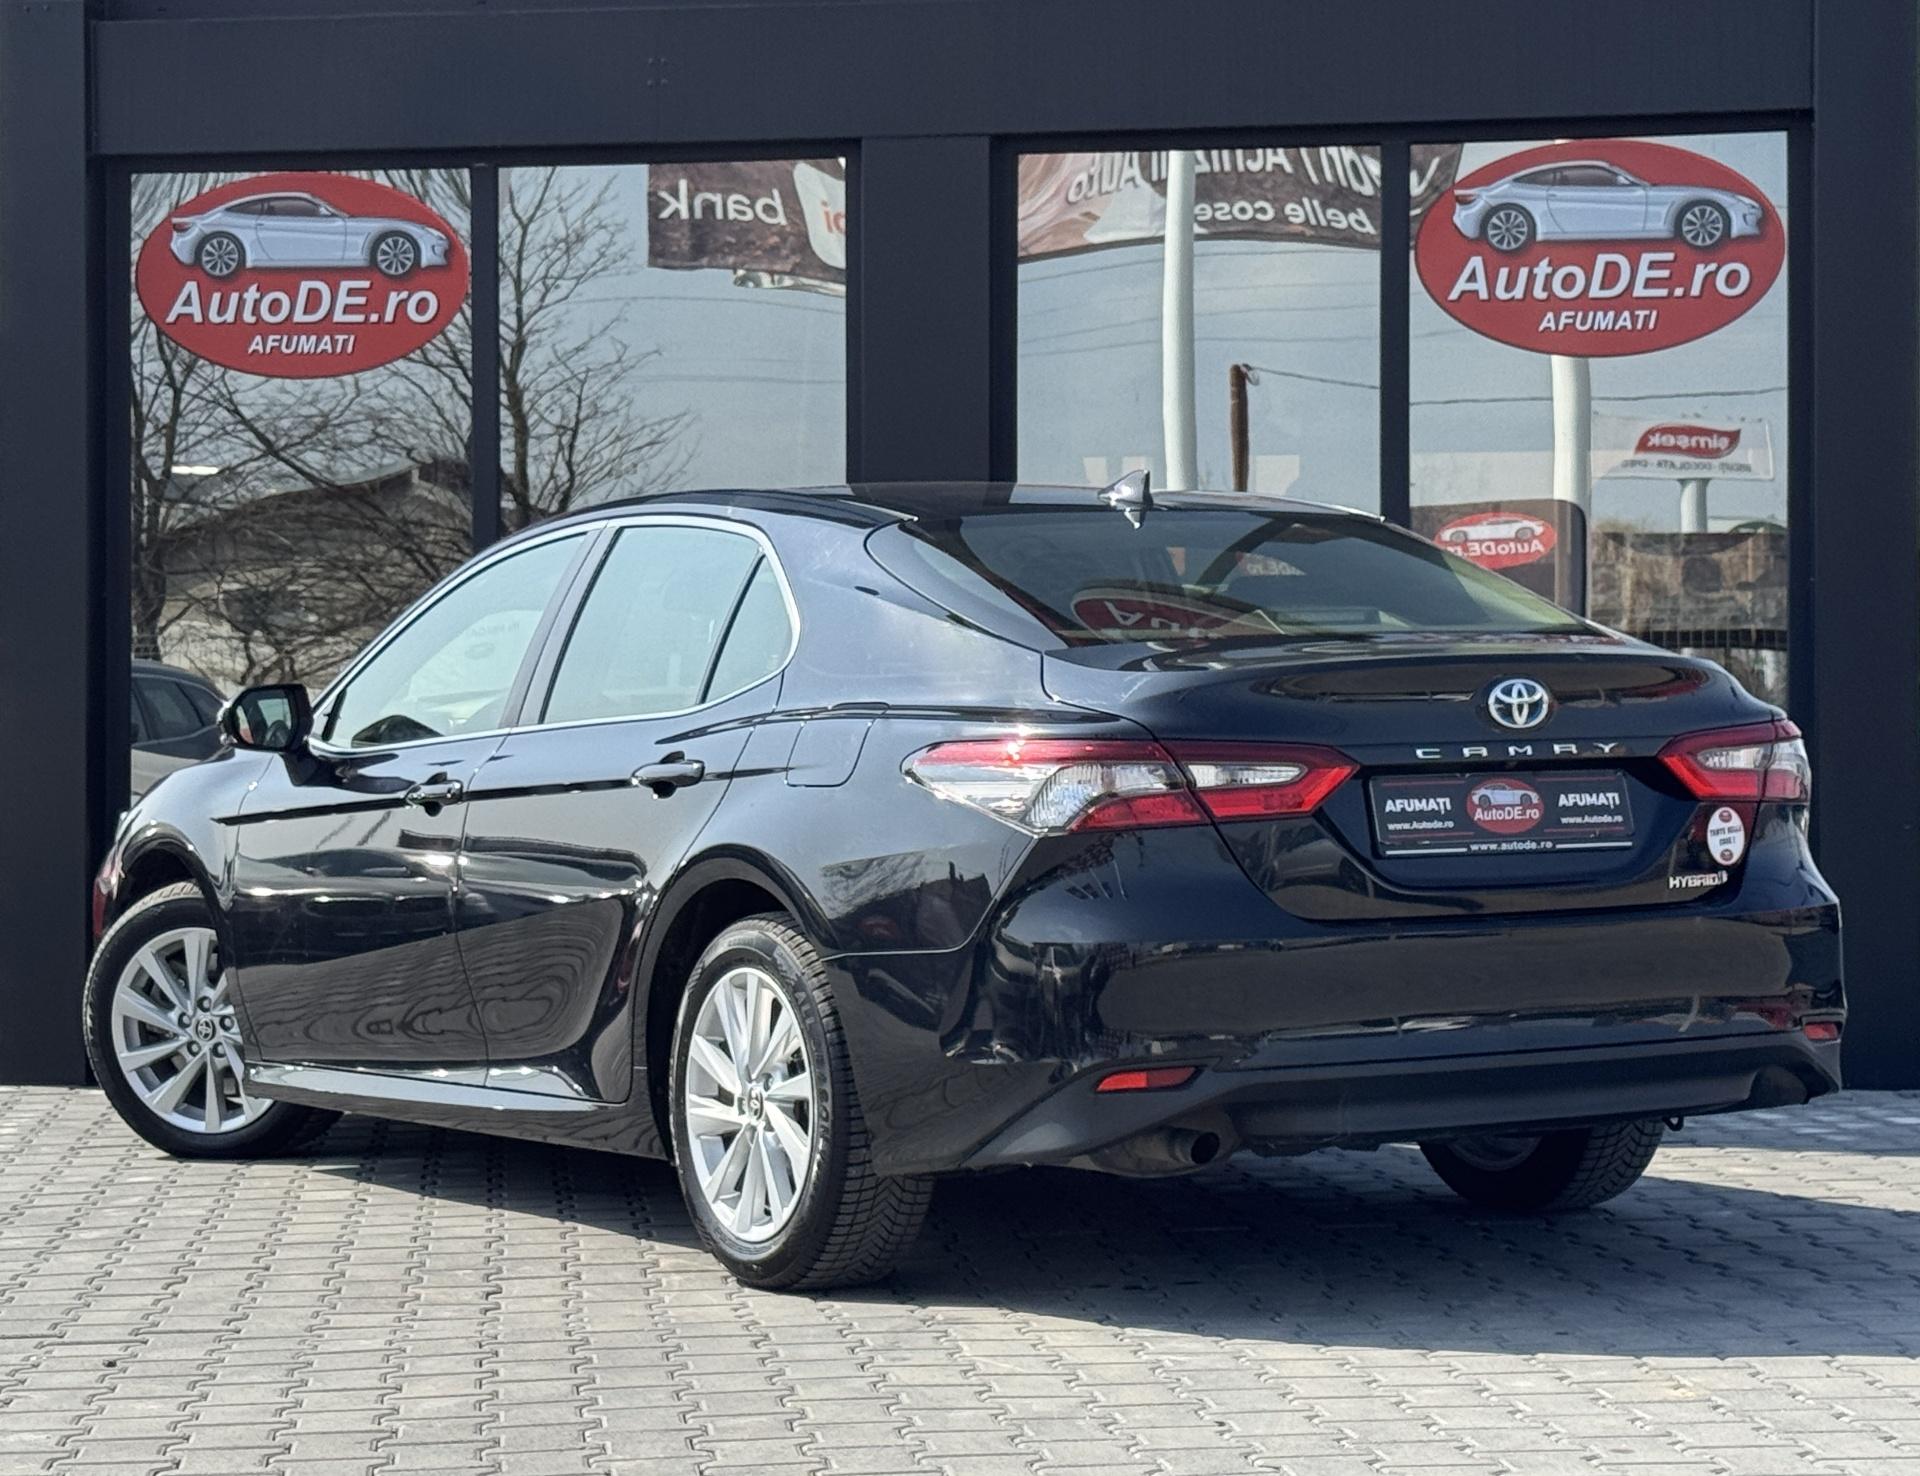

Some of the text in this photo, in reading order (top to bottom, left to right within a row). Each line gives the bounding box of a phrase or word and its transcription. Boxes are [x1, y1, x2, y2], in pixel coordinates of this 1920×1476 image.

[1448, 251, 1751, 301] AutoDE.ro
[165, 280, 440, 324] AutoDE.ro
[1538, 309, 1658, 332] AFUMATI
[247, 334, 355, 354] AFUMATI
[1415, 742, 1618, 759] CAMRY
[1474, 806, 1539, 821] AutoDE.ro
[1470, 841, 1553, 851] www.autode.ro
[1669, 873, 1718, 889] HYBRID
